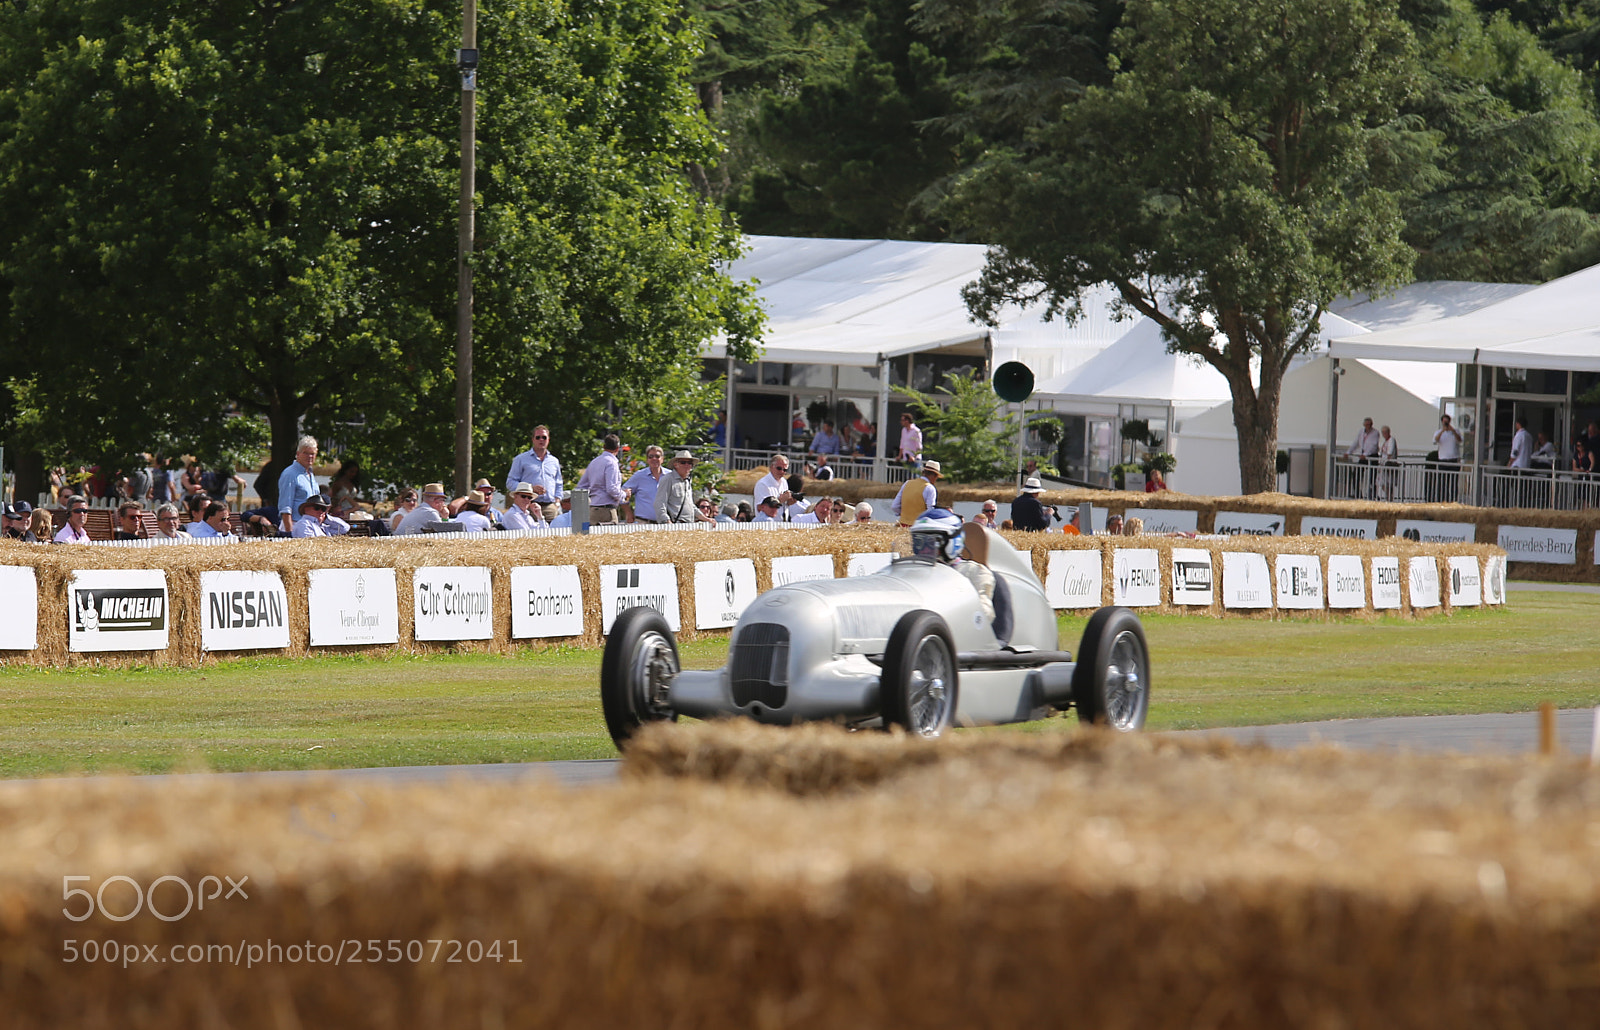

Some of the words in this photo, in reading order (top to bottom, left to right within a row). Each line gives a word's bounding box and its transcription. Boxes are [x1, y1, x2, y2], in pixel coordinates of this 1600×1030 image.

[1311, 527, 1365, 539] SAMSUNG
[1501, 535, 1573, 554] Mercedes-Benz
[1063, 564, 1092, 595] Cartier
[1131, 569, 1156, 586] RENAULT
[1186, 567, 1210, 582] MICHELIN
[1336, 568, 1361, 592] Bonhams
[101, 597, 162, 619] MICHELIN
[209, 590, 283, 629] NISSAN
[419, 583, 440, 622] The
[443, 582, 489, 623] Telegraph
[528, 587, 573, 616] Bonhams
[340, 610, 356, 627] Veuve
